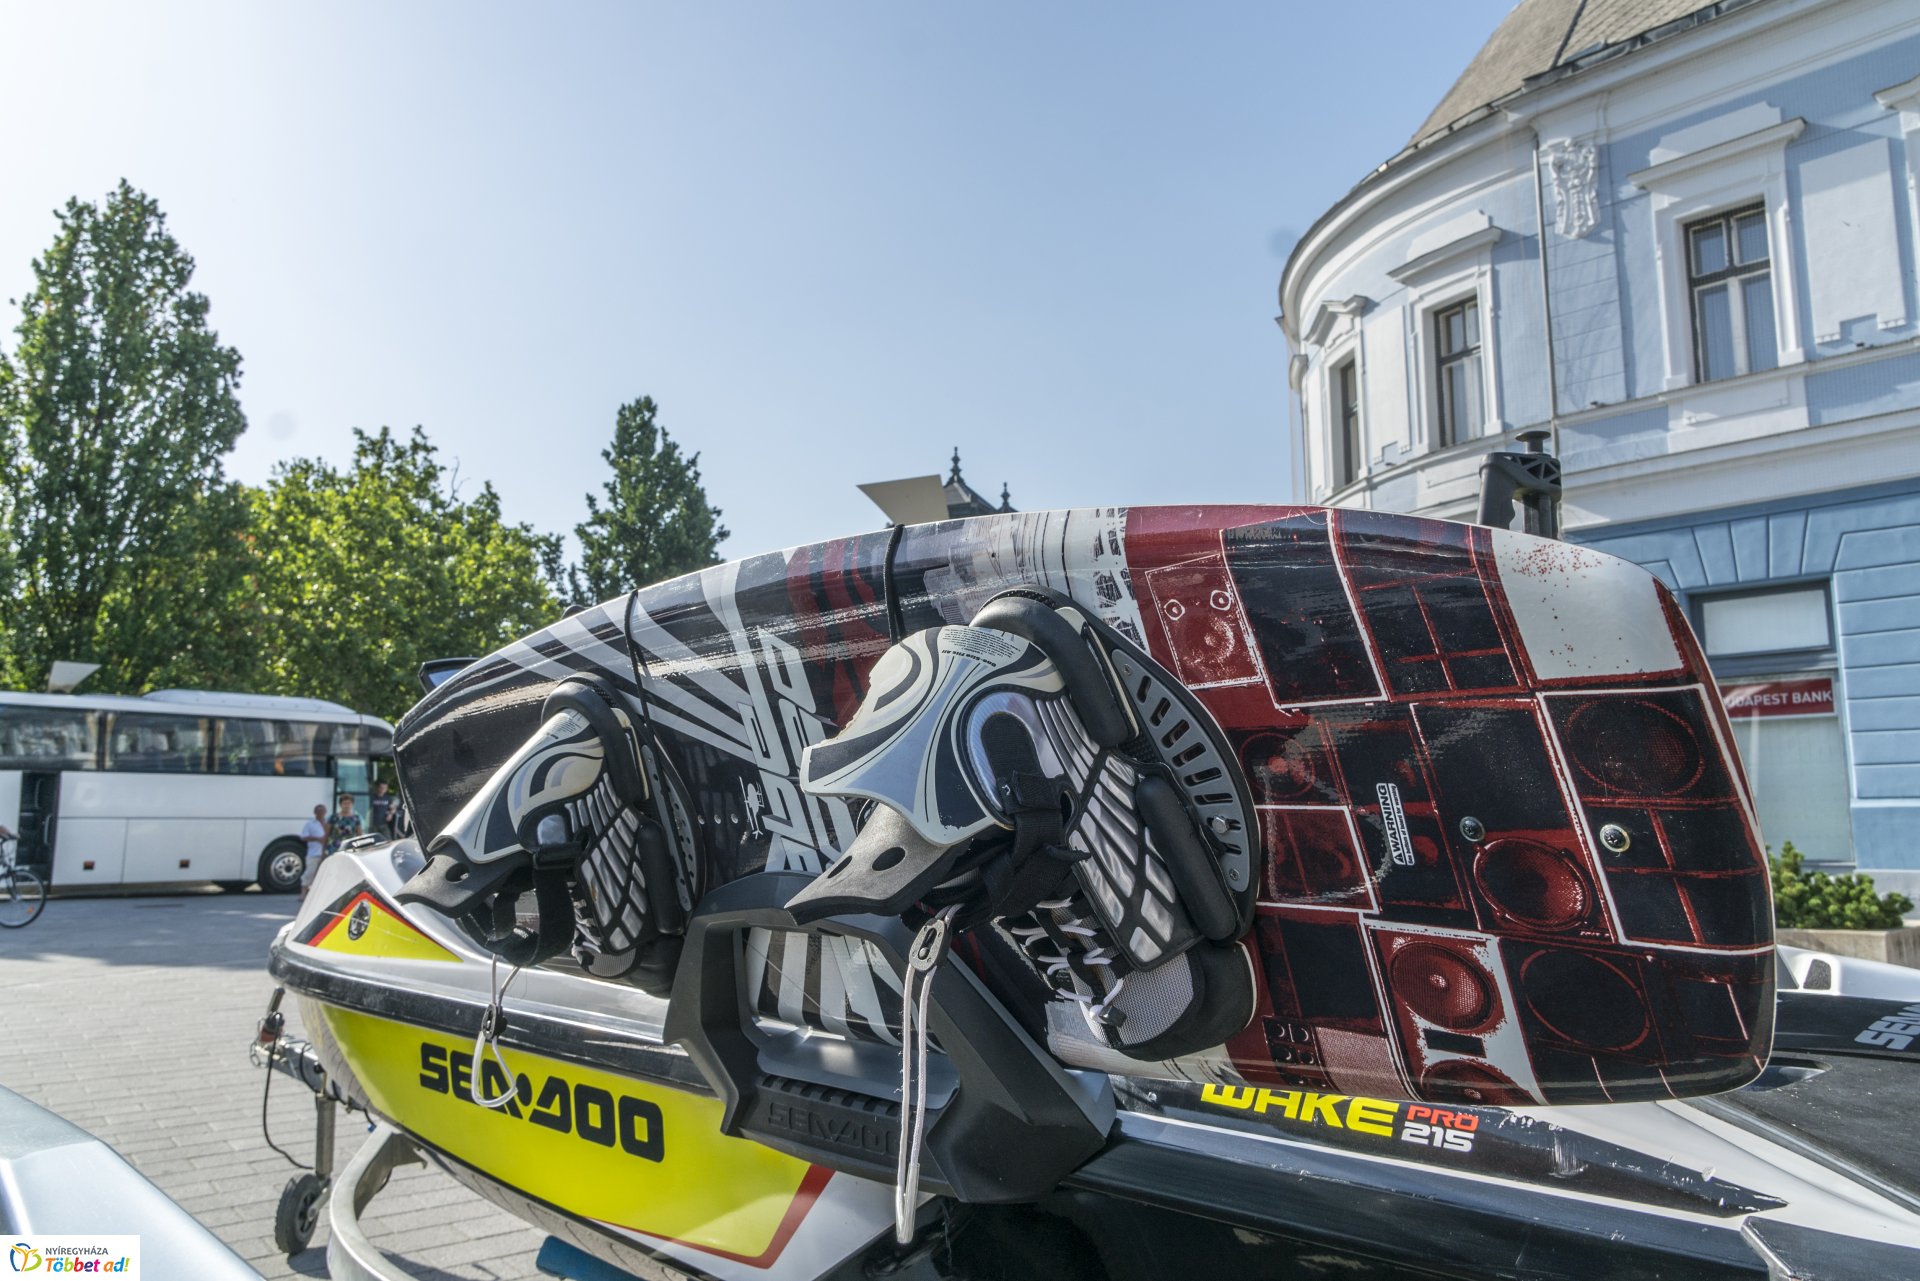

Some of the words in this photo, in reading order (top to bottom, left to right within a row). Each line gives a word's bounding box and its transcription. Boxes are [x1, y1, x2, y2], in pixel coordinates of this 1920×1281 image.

[1723, 692, 1788, 707] UDAPEST
[1792, 690, 1833, 704] BANK
[1378, 785, 1401, 853] WARNING
[1200, 1083, 1399, 1137] WAKE
[1406, 1104, 1479, 1132] PRO
[1401, 1121, 1475, 1152] 215
